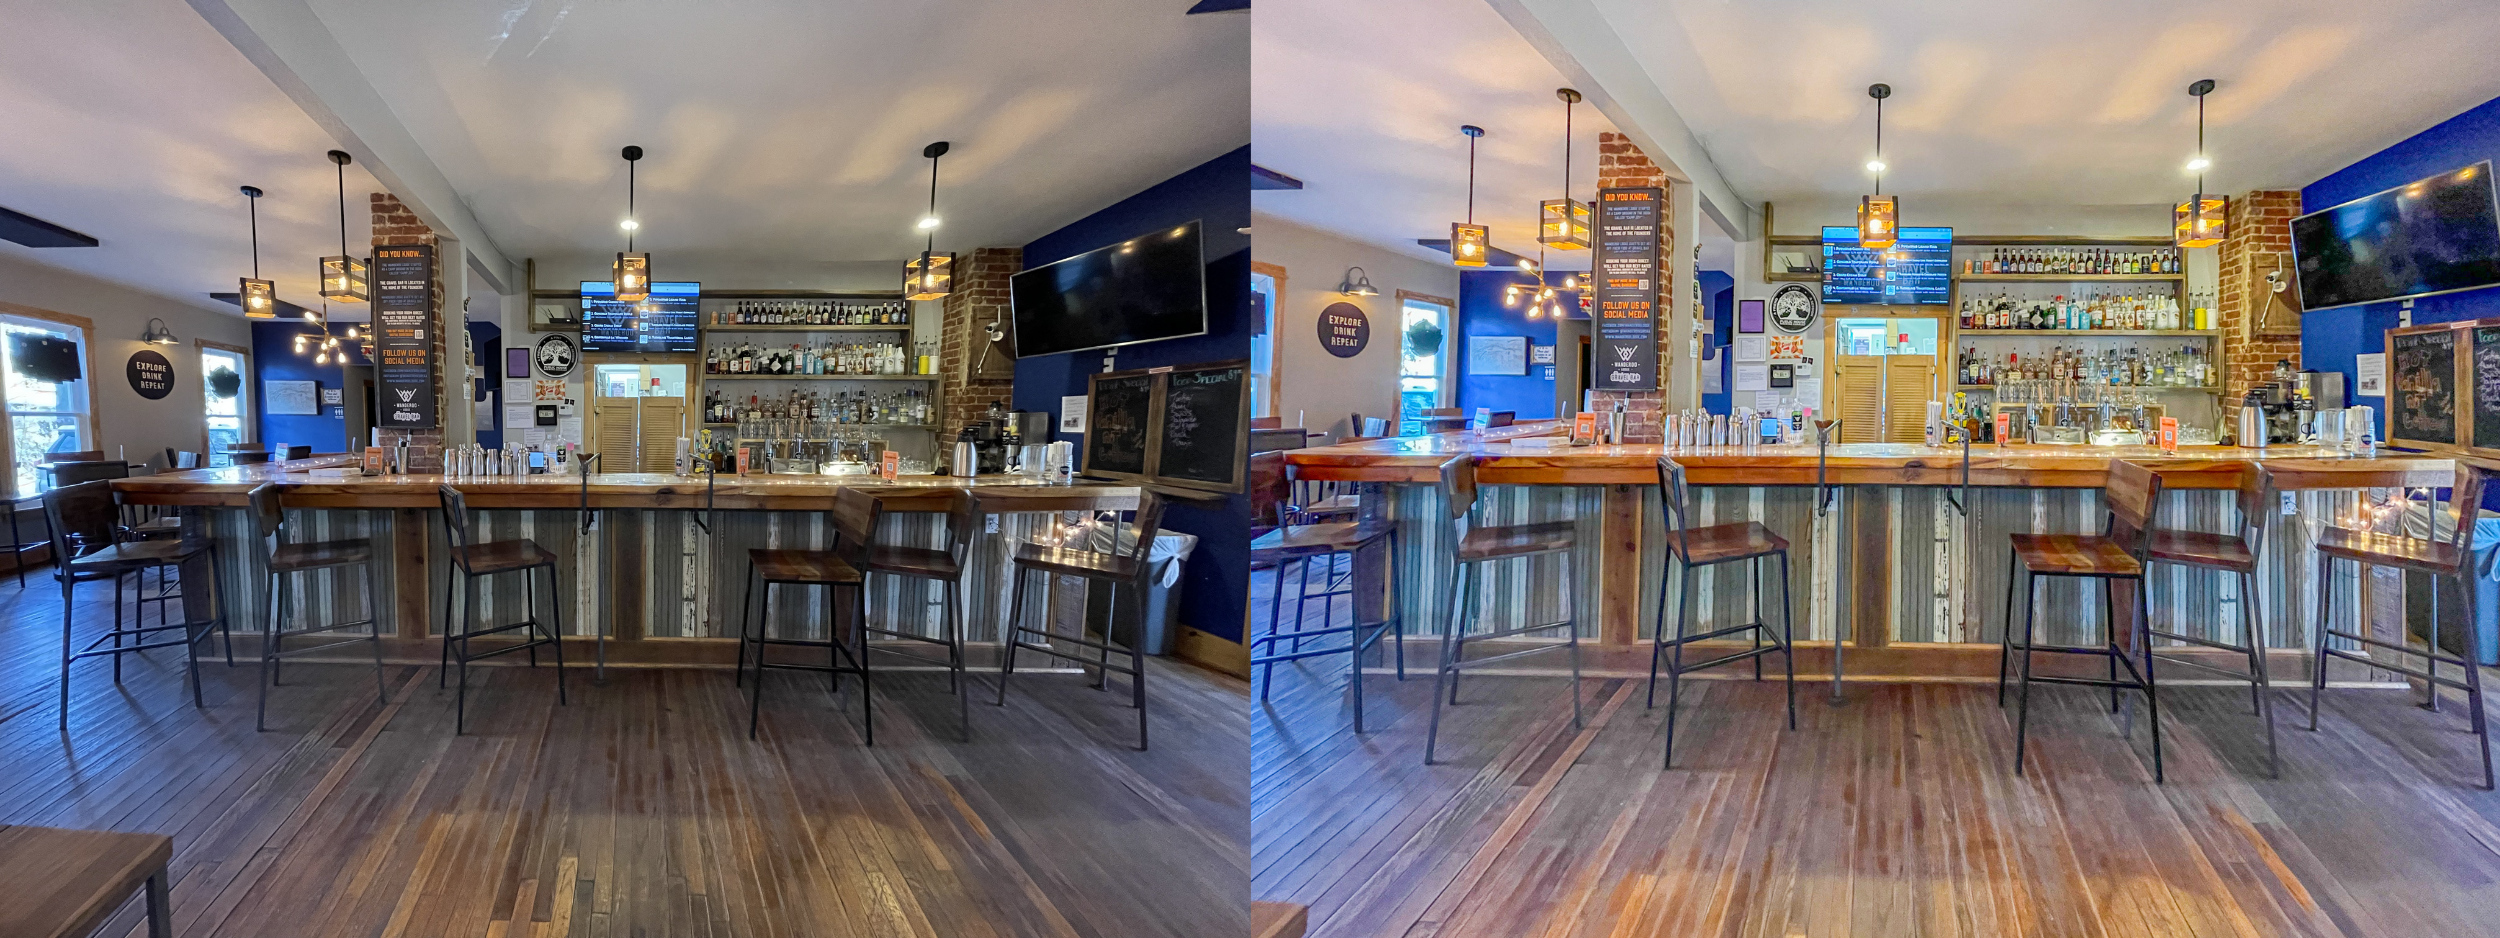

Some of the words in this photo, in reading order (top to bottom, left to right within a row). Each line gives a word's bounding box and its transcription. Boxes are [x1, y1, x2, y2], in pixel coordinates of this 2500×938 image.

[1602, 302, 1629, 310] FOLLOW
[1630, 302, 1640, 310] US
[1641, 302, 1650, 310] ON
[1329, 315, 1362, 326] EXPLORE
[2002, 314, 2008, 324] 7
[1334, 326, 1356, 336] DRINK
[1331, 336, 1358, 346] REPEAT
[136, 362, 167, 372] EXPLORE
[744, 360, 750, 370] 7
[142, 372, 162, 380] DRINK
[140, 380, 165, 390] REPEAT
